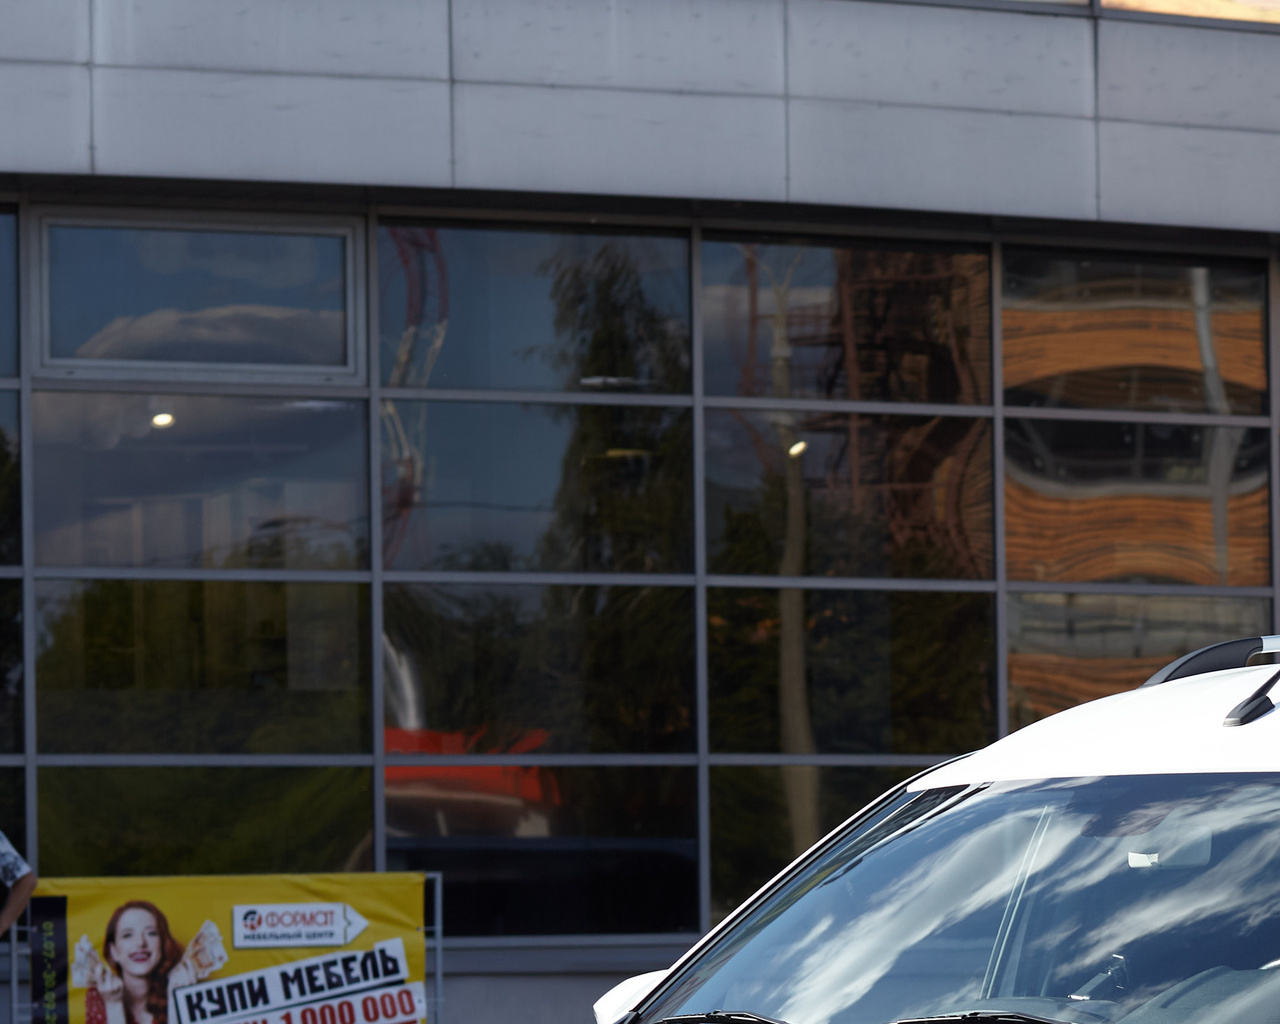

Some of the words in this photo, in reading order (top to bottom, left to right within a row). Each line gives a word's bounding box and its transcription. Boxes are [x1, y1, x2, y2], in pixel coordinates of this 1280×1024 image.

[265, 911, 334, 928] ФОРМАТ
[185, 980, 269, 1024] КУПИ
[282, 947, 401, 1001] МЕБЕЛЬ
[362, 988, 417, 1021] 000
